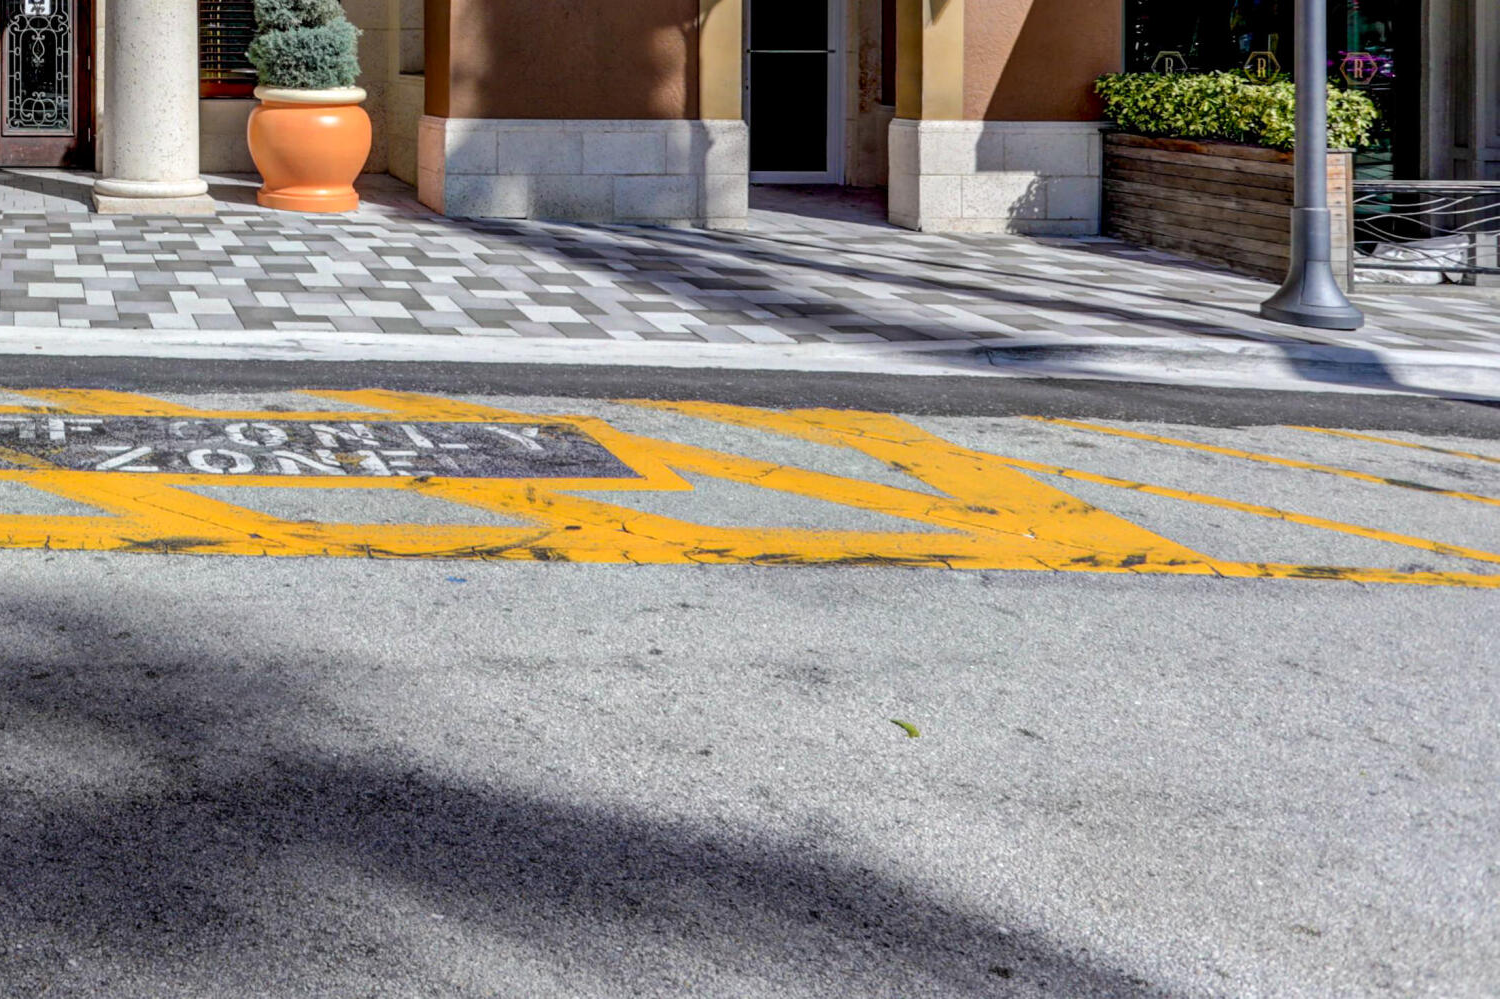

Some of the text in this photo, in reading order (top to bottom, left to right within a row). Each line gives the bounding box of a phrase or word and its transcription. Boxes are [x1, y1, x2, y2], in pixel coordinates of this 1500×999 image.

[1257, 58, 1267, 78] R
[1354, 58, 1364, 79] R
[225, 421, 544, 451] ONLY
[95, 445, 436, 477] ZONE
